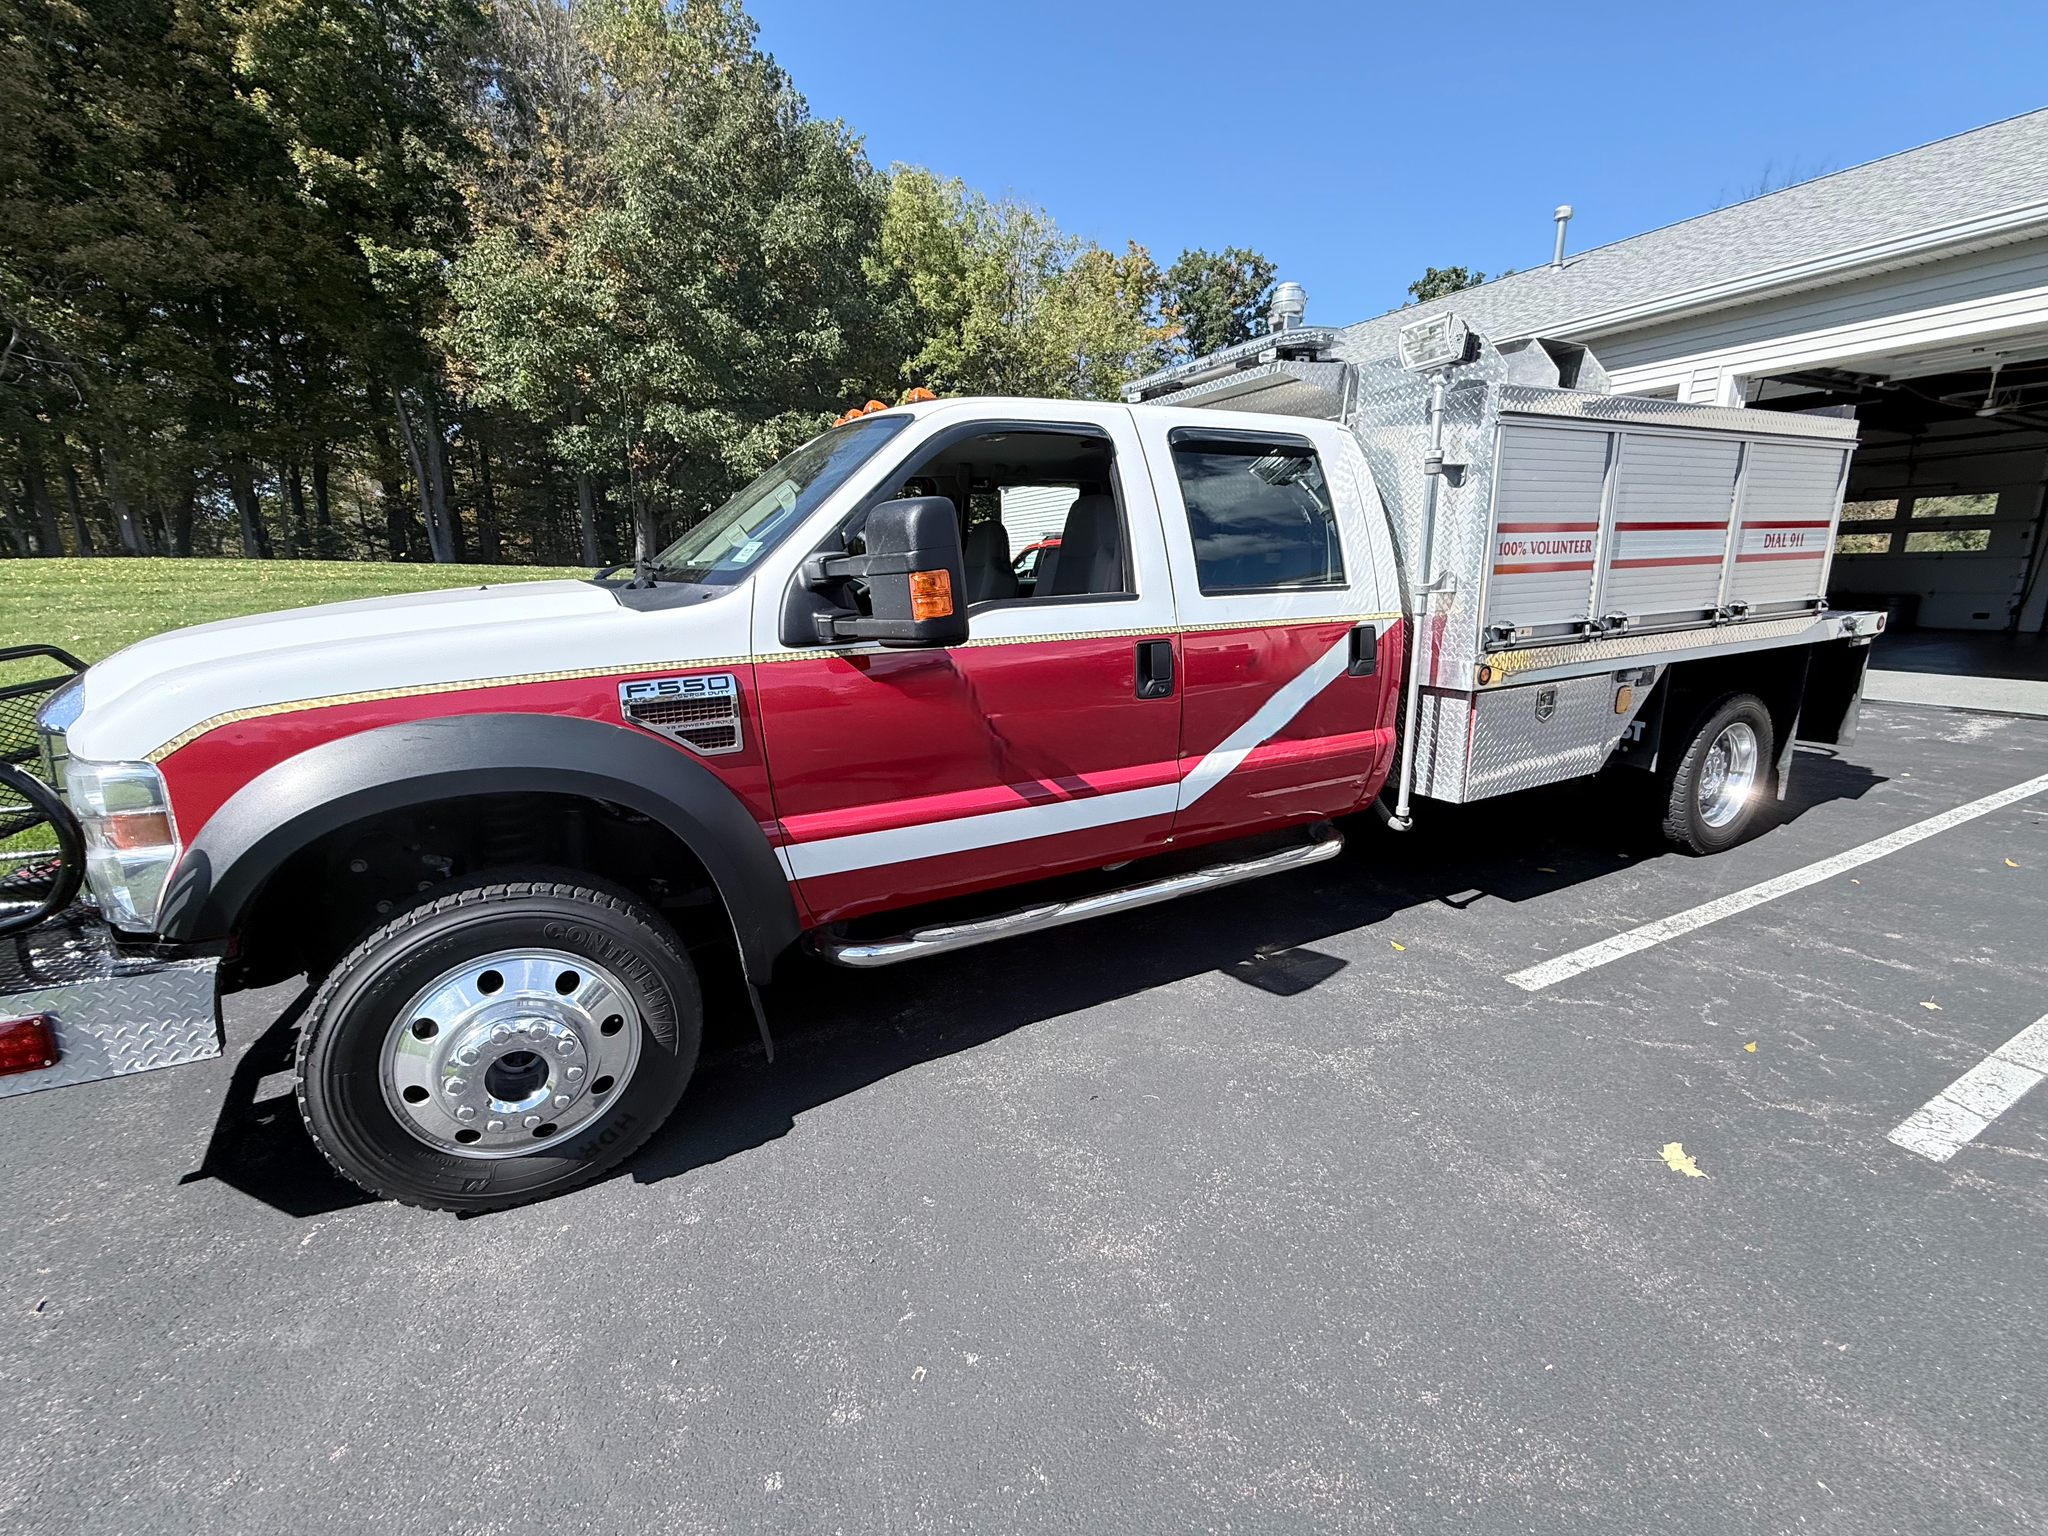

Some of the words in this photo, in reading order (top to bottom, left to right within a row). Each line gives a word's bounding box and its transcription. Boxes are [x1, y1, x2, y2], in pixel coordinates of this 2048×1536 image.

[1499, 541, 1527, 556] 100%
[1530, 539, 1592, 555] VOLUNTEER
[1763, 533, 1786, 548] DIAL
[1790, 532, 1805, 547] 911
[625, 675, 730, 698] F-550
[543, 921, 674, 1043] CONTINENTAL
